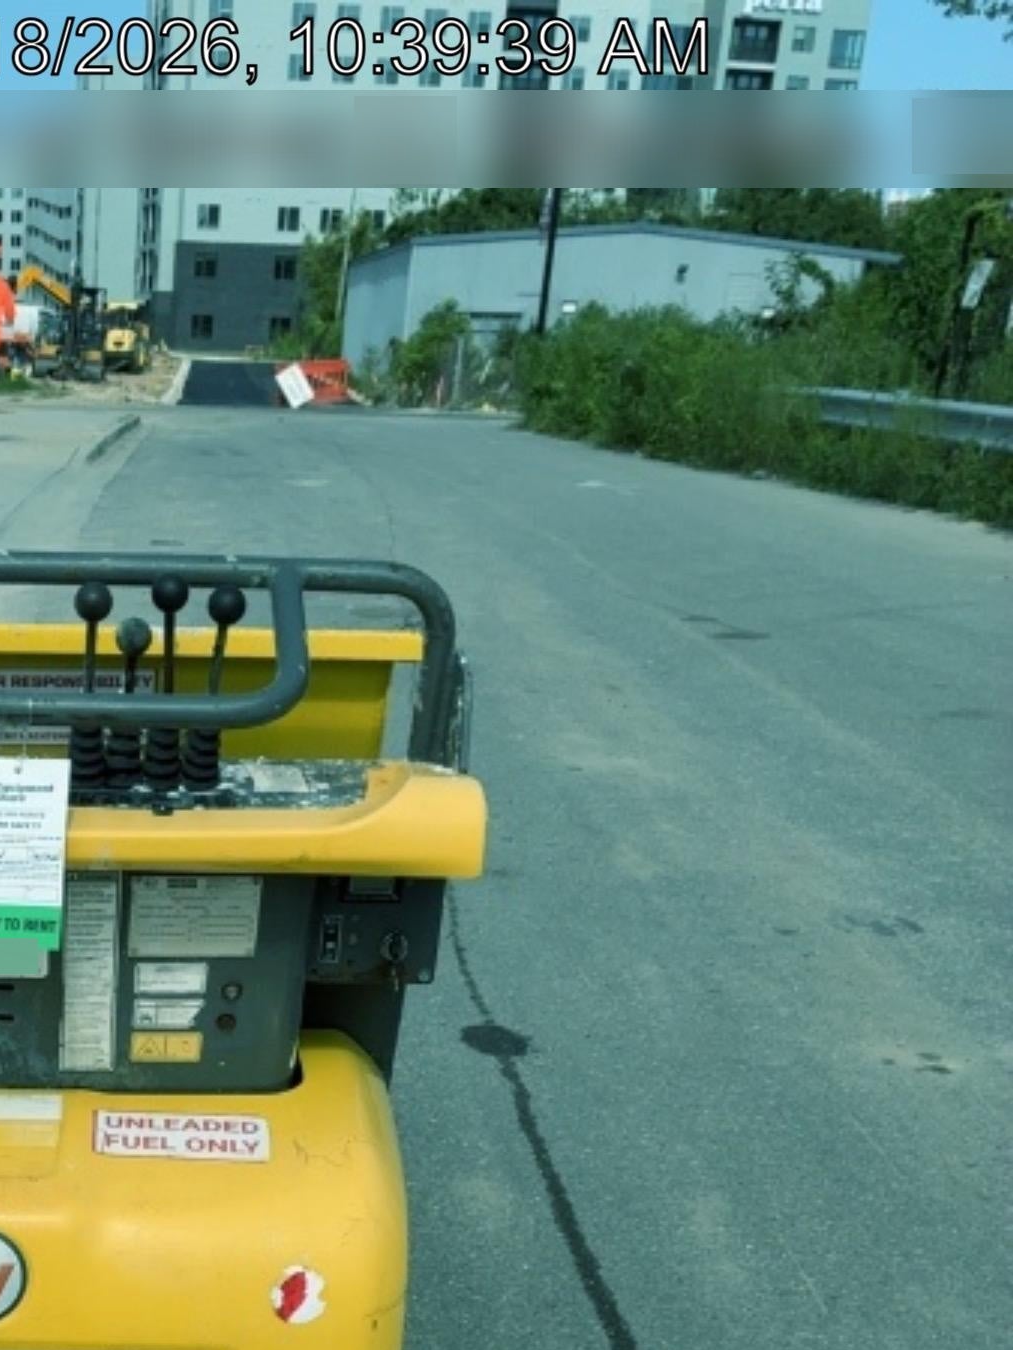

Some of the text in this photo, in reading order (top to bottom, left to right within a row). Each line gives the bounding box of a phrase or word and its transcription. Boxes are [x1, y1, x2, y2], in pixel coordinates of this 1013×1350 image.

[4, 917, 20, 931] TO
[22, 918, 57, 933] RENT
[105, 1115, 260, 1135] UNLEADED
[103, 1132, 261, 1154] FUEL ONLY
